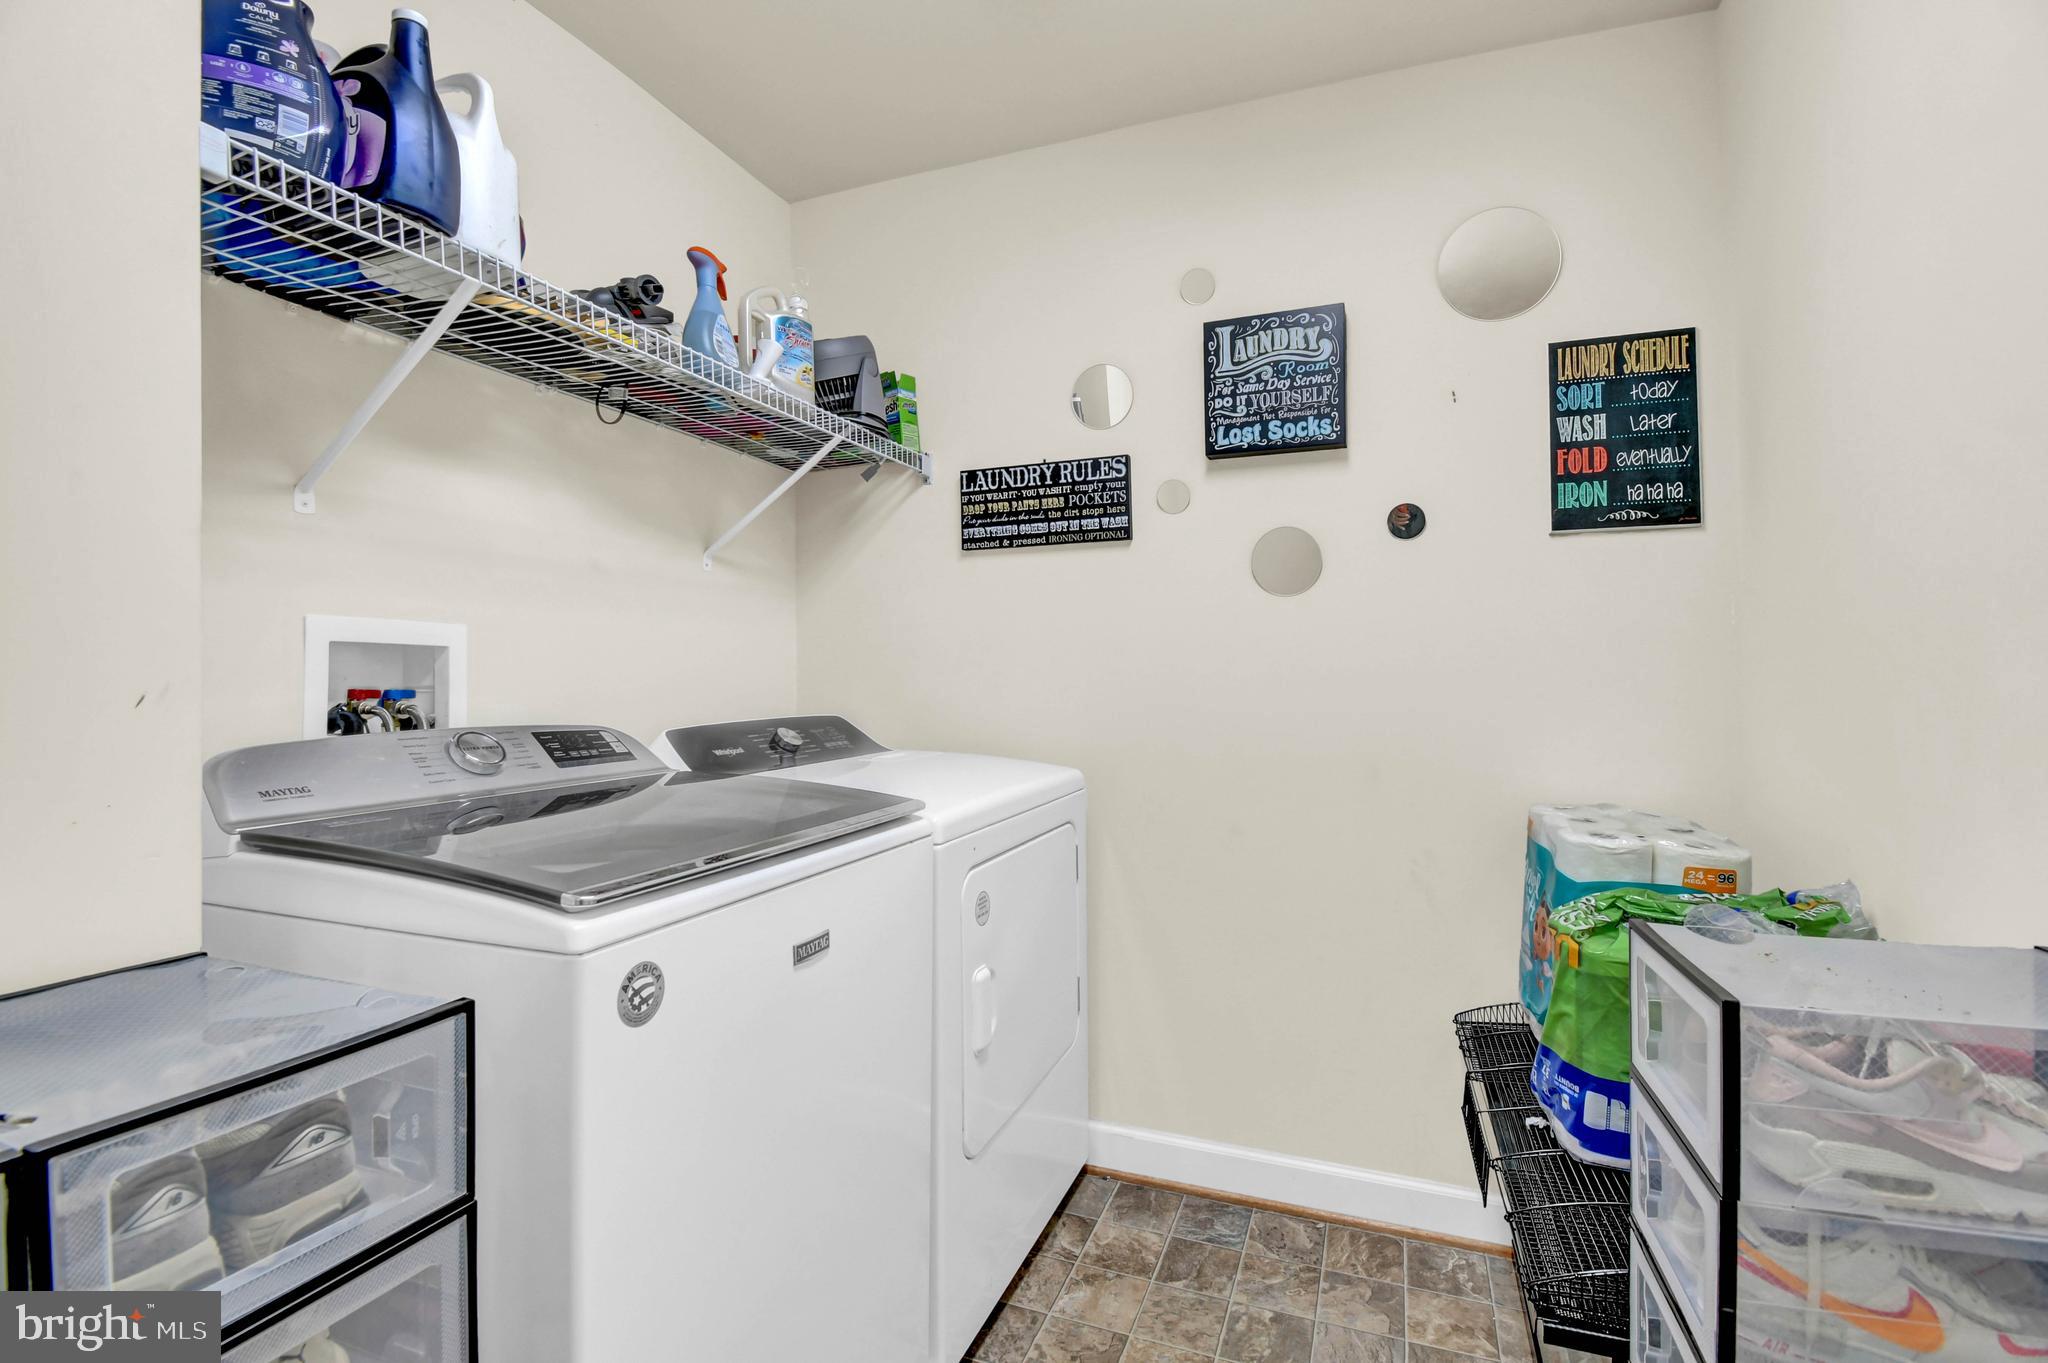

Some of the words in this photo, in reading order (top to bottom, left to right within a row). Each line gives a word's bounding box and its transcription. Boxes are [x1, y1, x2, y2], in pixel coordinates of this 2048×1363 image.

[242, 2, 280, 20] Downy
[248, 13, 273, 23] CALM
[1215, 325, 1321, 376] LAUNDRY
[1557, 342, 1616, 381] LAUNDRY
[1622, 334, 1690, 374] SCHEDULE
[1278, 361, 1330, 377] Room
[1214, 384, 1234, 396] For
[1236, 381, 1265, 394] Same
[1266, 377, 1291, 390] Day
[1293, 373, 1332, 387] Service
[1214, 397, 1233, 409] DO
[1236, 395, 1247, 406] IT
[1250, 384, 1333, 409] YOURSELF
[1556, 381, 1606, 412] SORT
[1216, 415, 1260, 425] Management
[1278, 406, 1318, 419] Responsible
[1216, 422, 1262, 446] Lost
[1268, 415, 1333, 440] Socks
[1556, 413, 1607, 443] WASH
[1556, 446, 1608, 475] FOLD
[961, 463, 1056, 492] LAUNDRY
[1059, 456, 1127, 483] RULES
[962, 495, 970, 503] IF
[970, 494, 985, 502] YOU
[1021, 489, 1037, 497] YOU
[1075, 481, 1103, 492] empty
[1106, 481, 1126, 491] your
[1557, 480, 1608, 509] IRON
[1627, 483, 1643, 501] ha
[1647, 482, 1663, 499] ha
[1667, 481, 1683, 499] ha
[962, 504, 985, 515] DROP
[987, 502, 1010, 513] YOUR
[1012, 499, 1040, 511] PANTS
[1041, 497, 1065, 509] HERE
[1068, 490, 1127, 506] POCKETS
[1064, 509, 1080, 517] dirt
[1082, 507, 1104, 516] stops
[1106, 505, 1126, 514] here
[962, 525, 1018, 539] EVERYTHING
[1019, 522, 1049, 534] COMES
[1049, 520, 1068, 532] OUT
[1069, 520, 1080, 531] IN
[1081, 518, 1100, 530] THE
[1100, 516, 1129, 529] WASH
[1048, 533, 1083, 543] IRONING
[1084, 530, 1127, 540] OPTIONAL
[963, 540, 1000, 549] starched
[1013, 535, 1046, 547] pressed
[257, 785, 312, 799] MAYTAG
[1684, 878, 1707, 886] MEGA
[1687, 871, 1704, 879] 24
[1717, 873, 1735, 884] 96
[797, 935, 829, 960] MAYTAG
